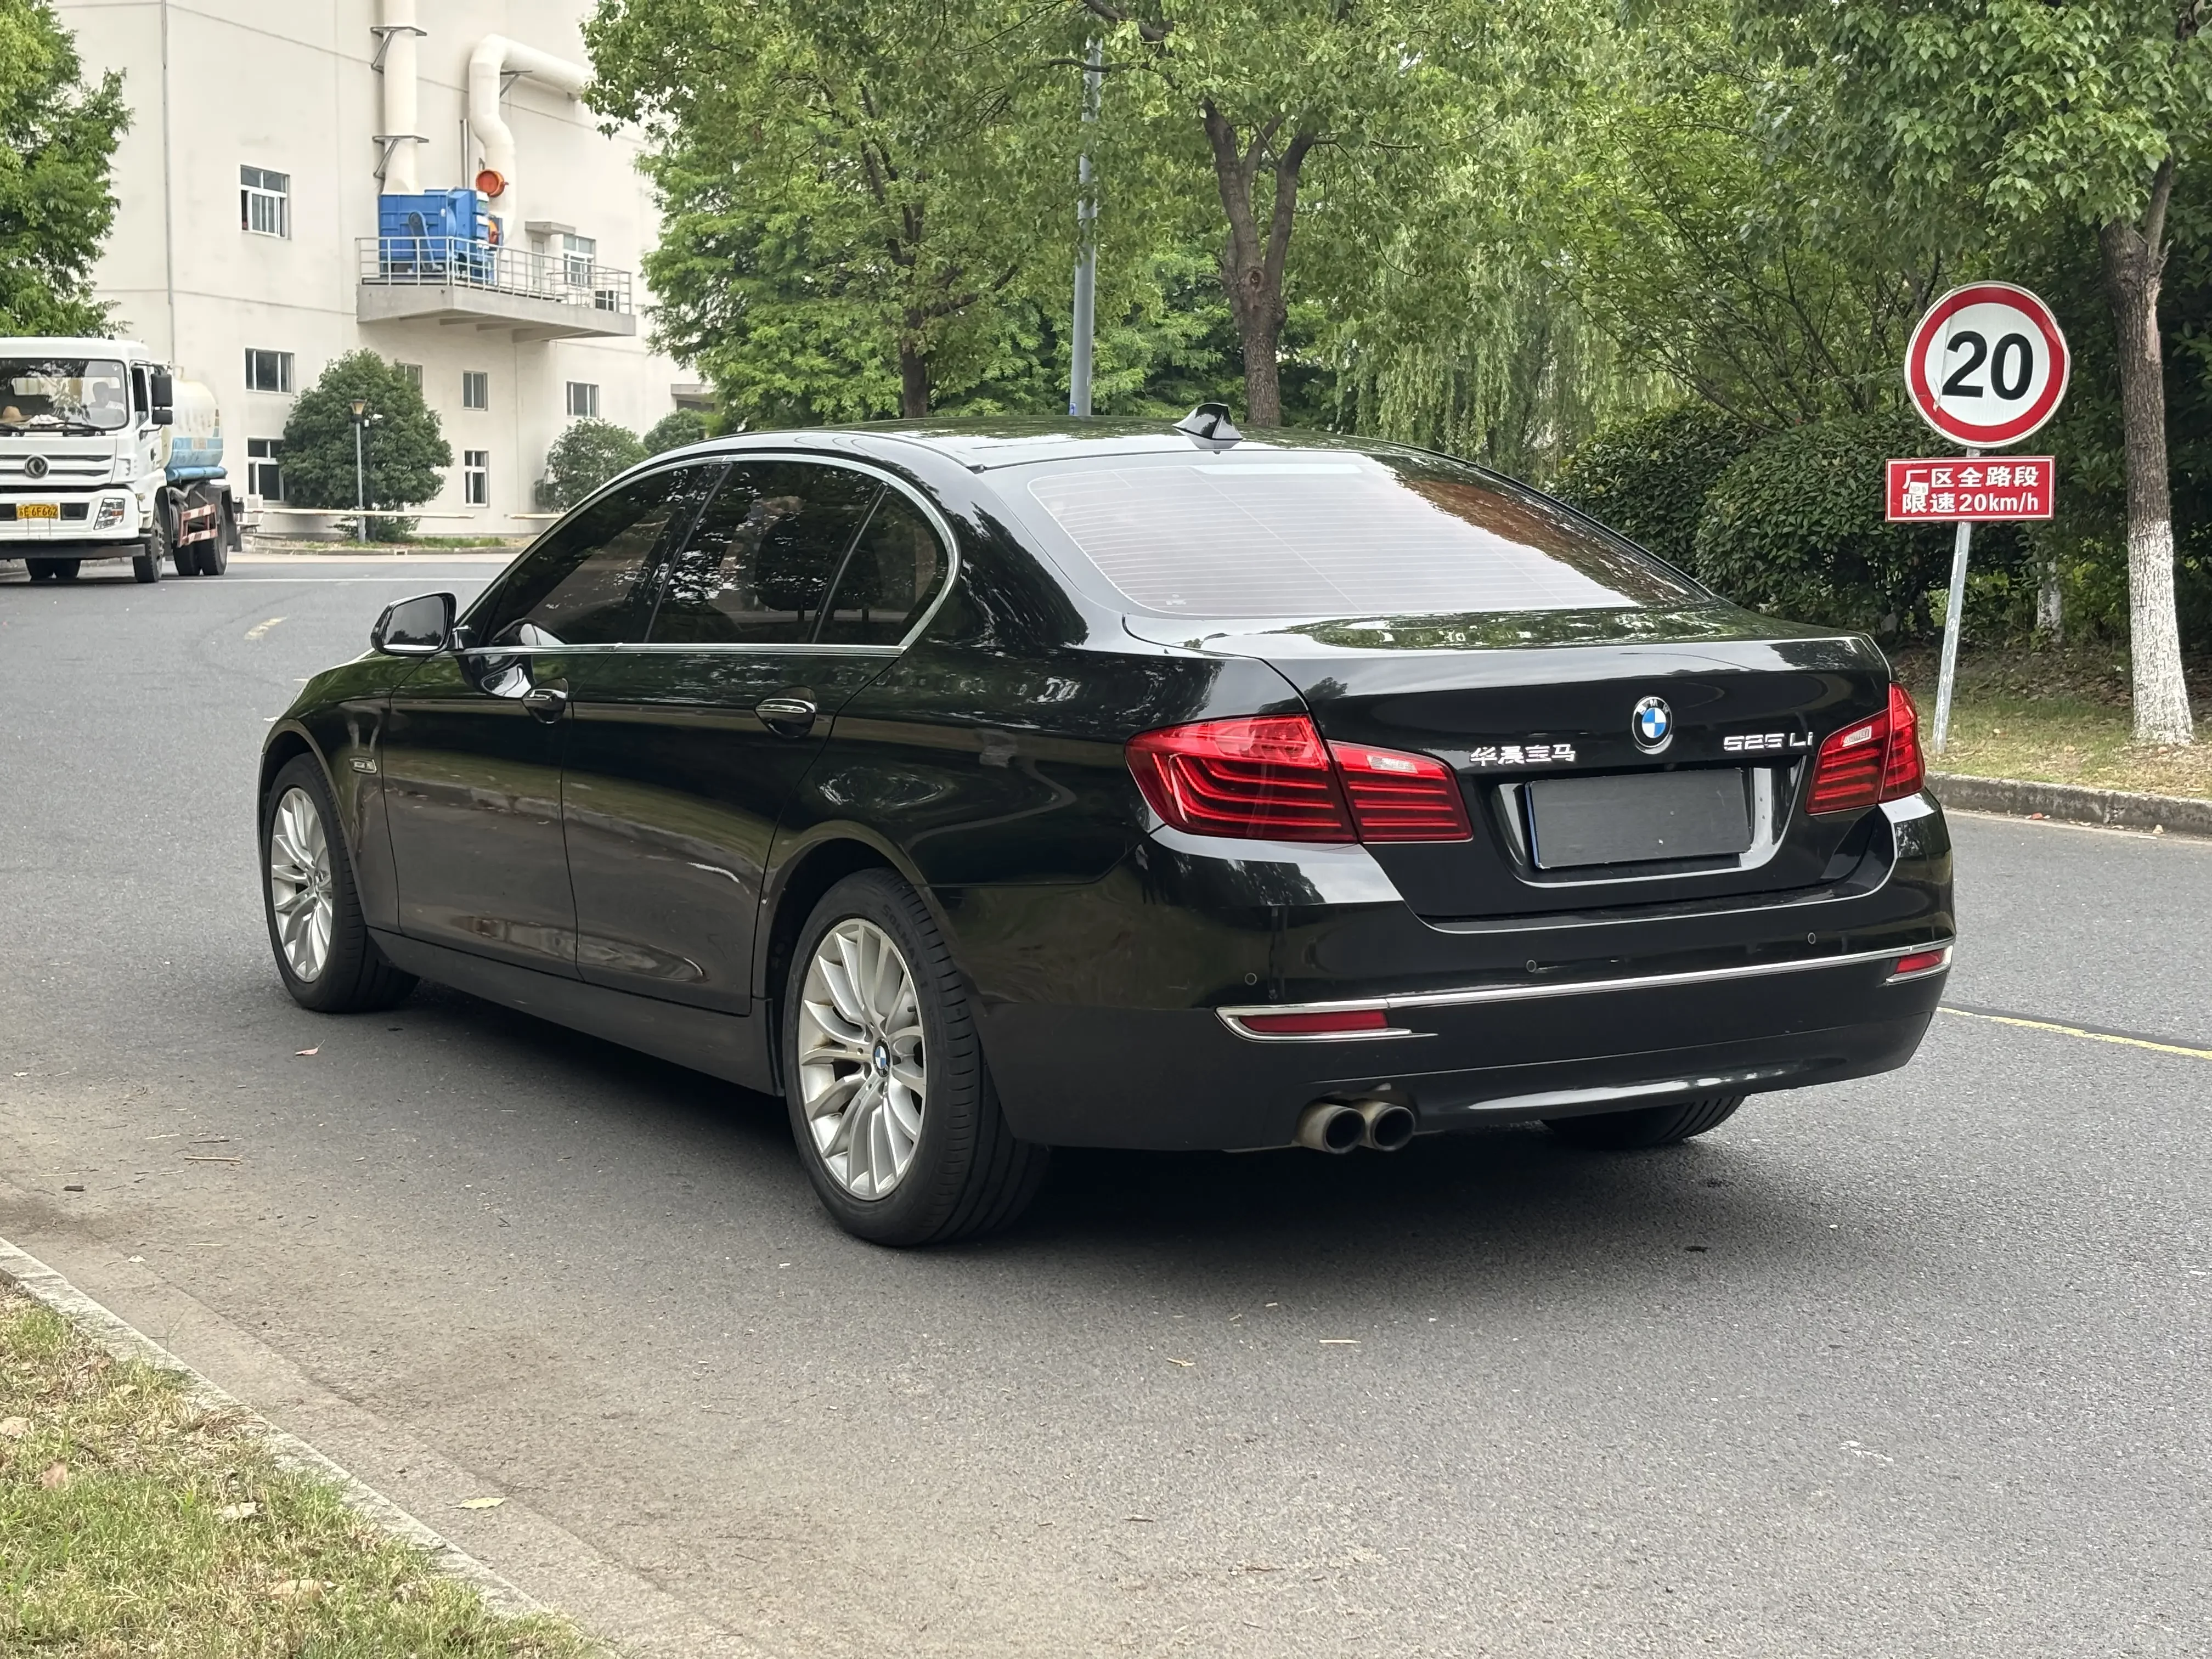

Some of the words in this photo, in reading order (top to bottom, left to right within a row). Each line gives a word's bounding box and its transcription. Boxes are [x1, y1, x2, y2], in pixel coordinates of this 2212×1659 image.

[1942, 331, 2033, 400] 20
[1902, 466, 2039, 489] 厂区全路段
[1901, 492, 2039, 514] 限速20km/h
[1470, 744, 1576, 766] 华晨宝马
